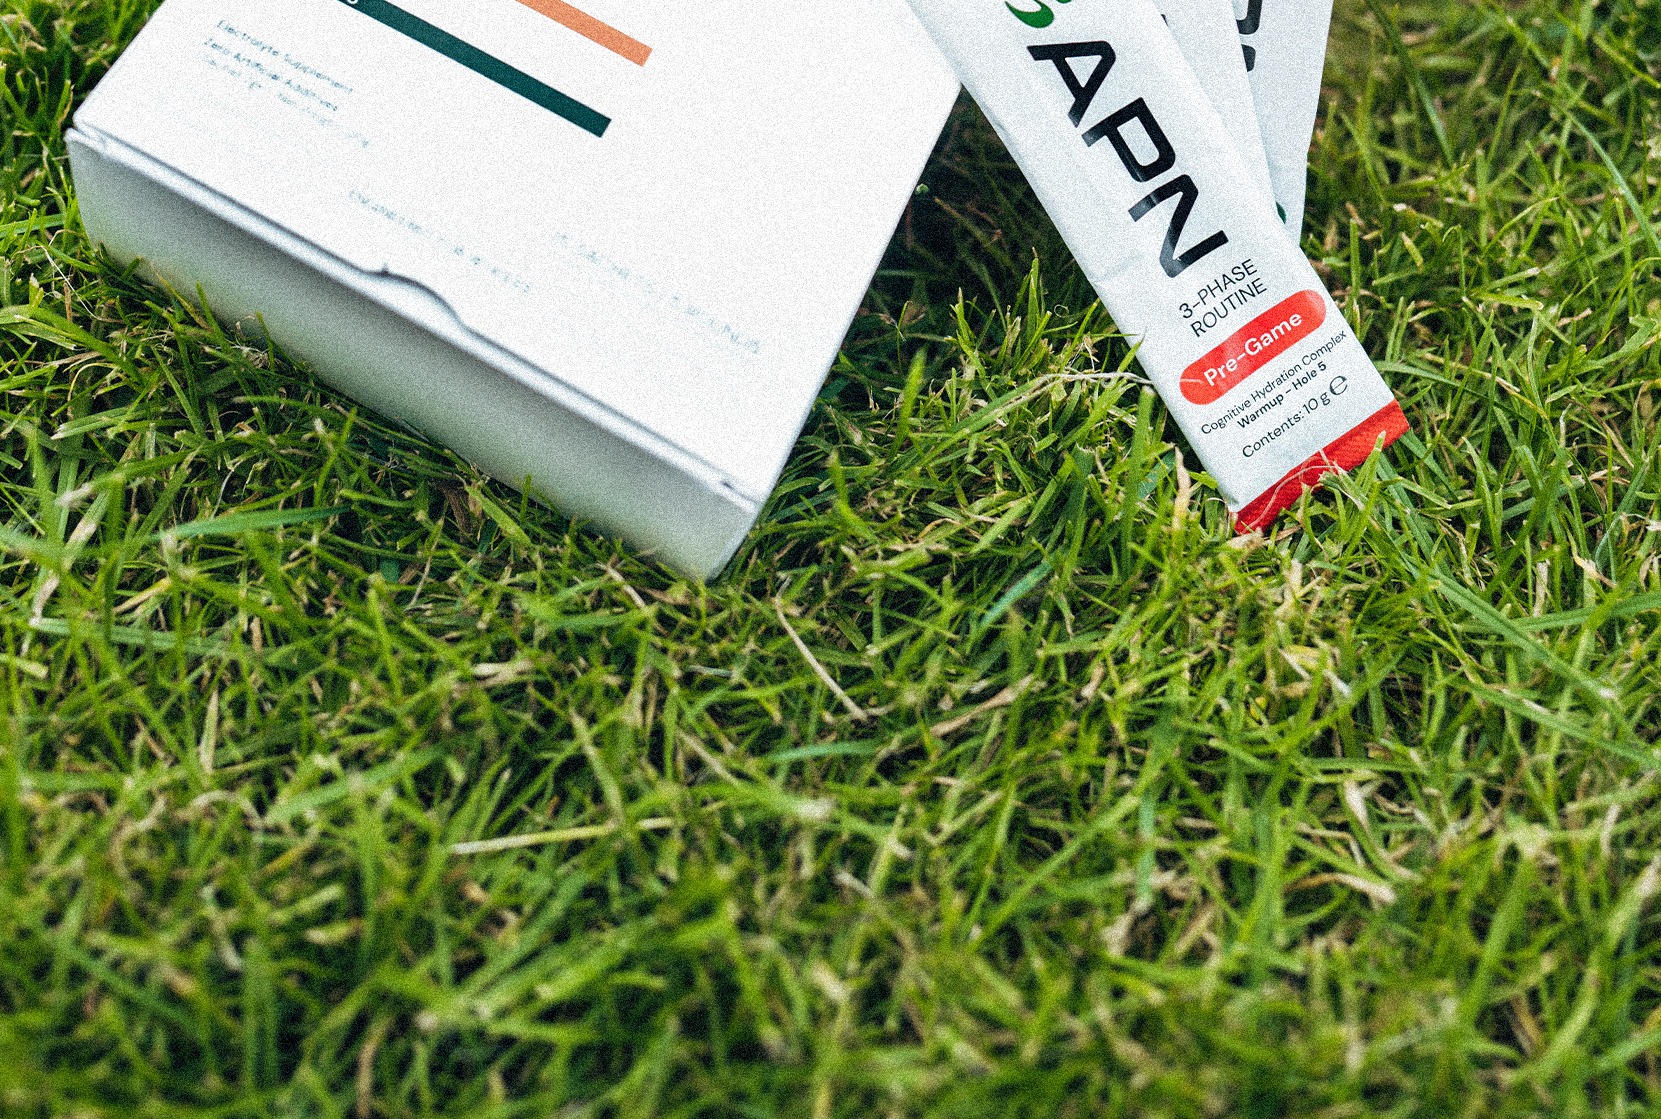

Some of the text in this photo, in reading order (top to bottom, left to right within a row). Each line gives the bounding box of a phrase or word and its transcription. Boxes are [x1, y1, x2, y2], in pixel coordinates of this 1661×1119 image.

[1179, 258, 1258, 319] 3-PHASE
[1190, 278, 1268, 338] ROUTINE
[1203, 312, 1303, 386] Pre-Game
[1201, 331, 1347, 435] Cognitive Hydration Complex
[1237, 393, 1285, 429] Warmup
[1292, 370, 1319, 392] Hole
[1318, 361, 1328, 371] 5
[1242, 410, 1305, 458] Contents:
[1304, 398, 1319, 414] 10
[1320, 394, 1331, 406] g
